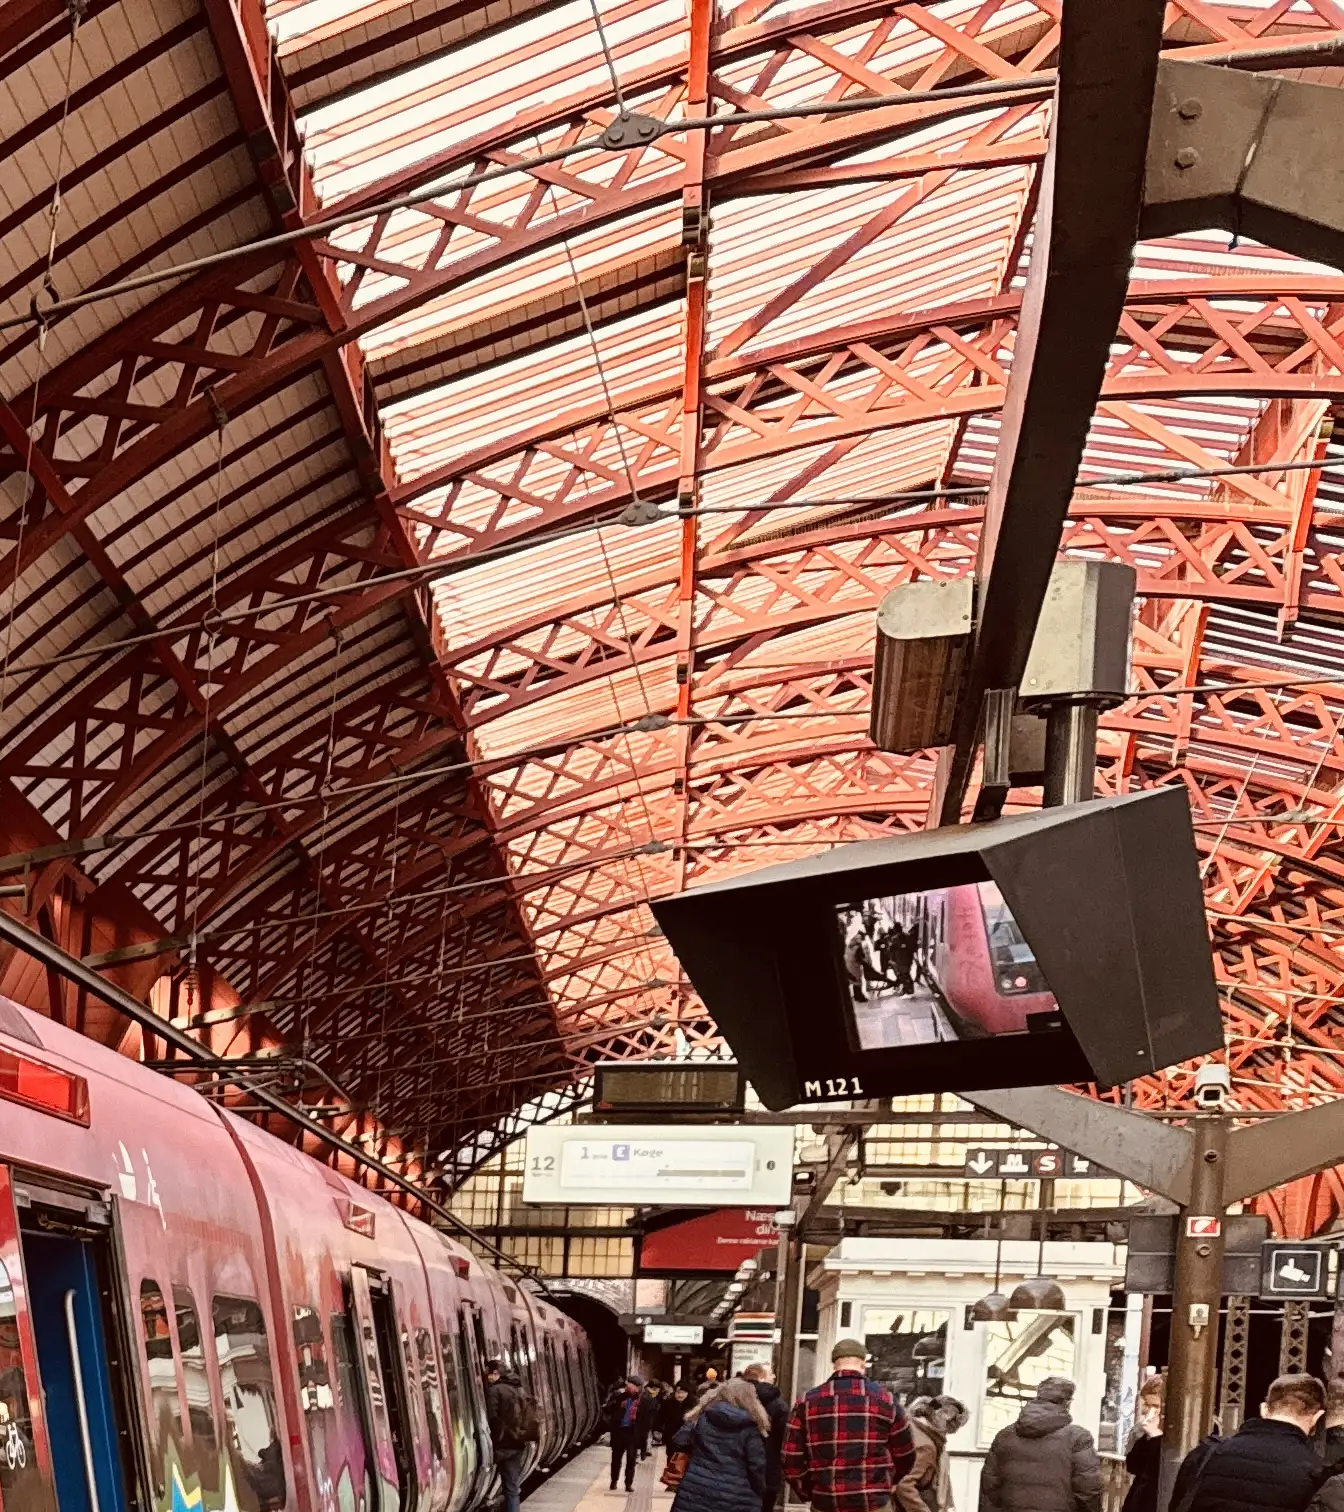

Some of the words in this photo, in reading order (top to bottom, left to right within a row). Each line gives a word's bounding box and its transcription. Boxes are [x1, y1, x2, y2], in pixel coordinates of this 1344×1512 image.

[805, 1080, 822, 1098] M
[825, 1076, 864, 1097] 121
[531, 1155, 556, 1172] 12
[1039, 1155, 1057, 1172] S
